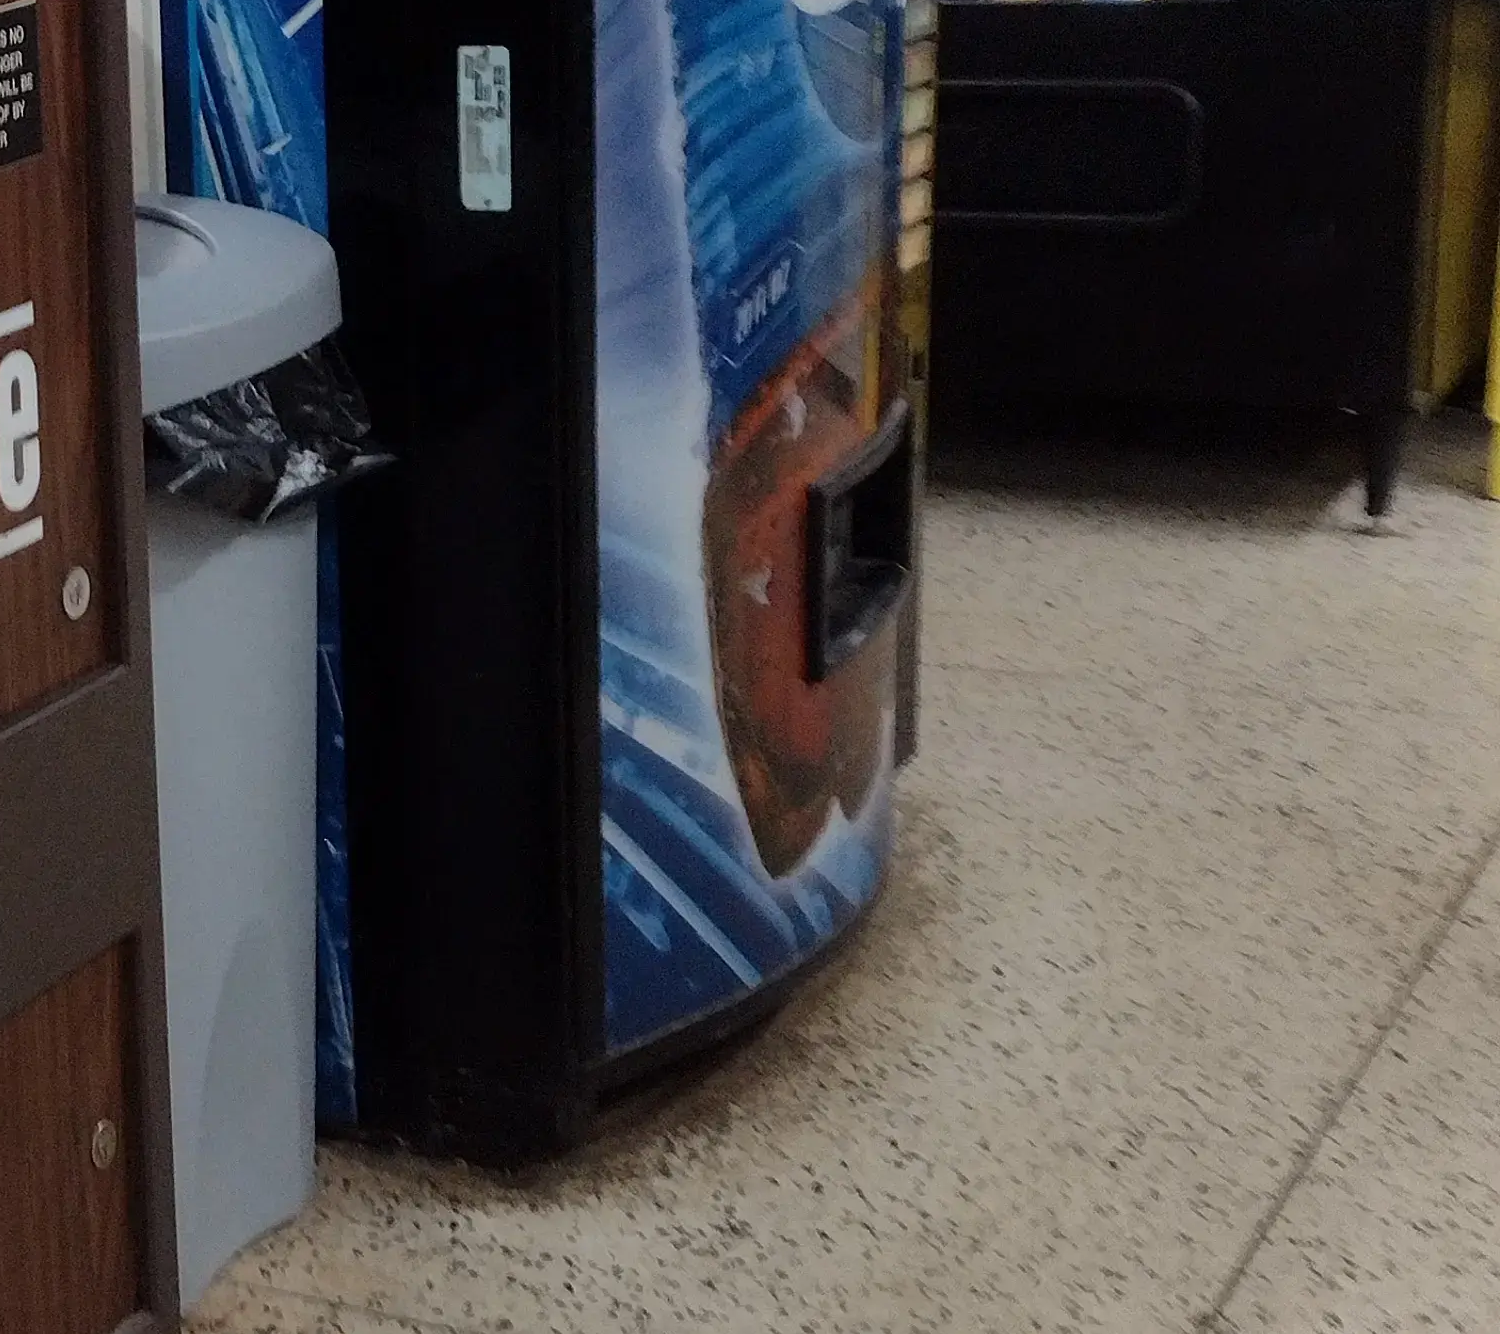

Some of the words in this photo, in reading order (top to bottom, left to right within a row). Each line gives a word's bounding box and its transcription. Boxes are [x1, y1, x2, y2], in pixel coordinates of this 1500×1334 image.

[9, 24, 25, 46] NO
[20, 71, 34, 93] BE
[12, 98, 26, 122] BY
